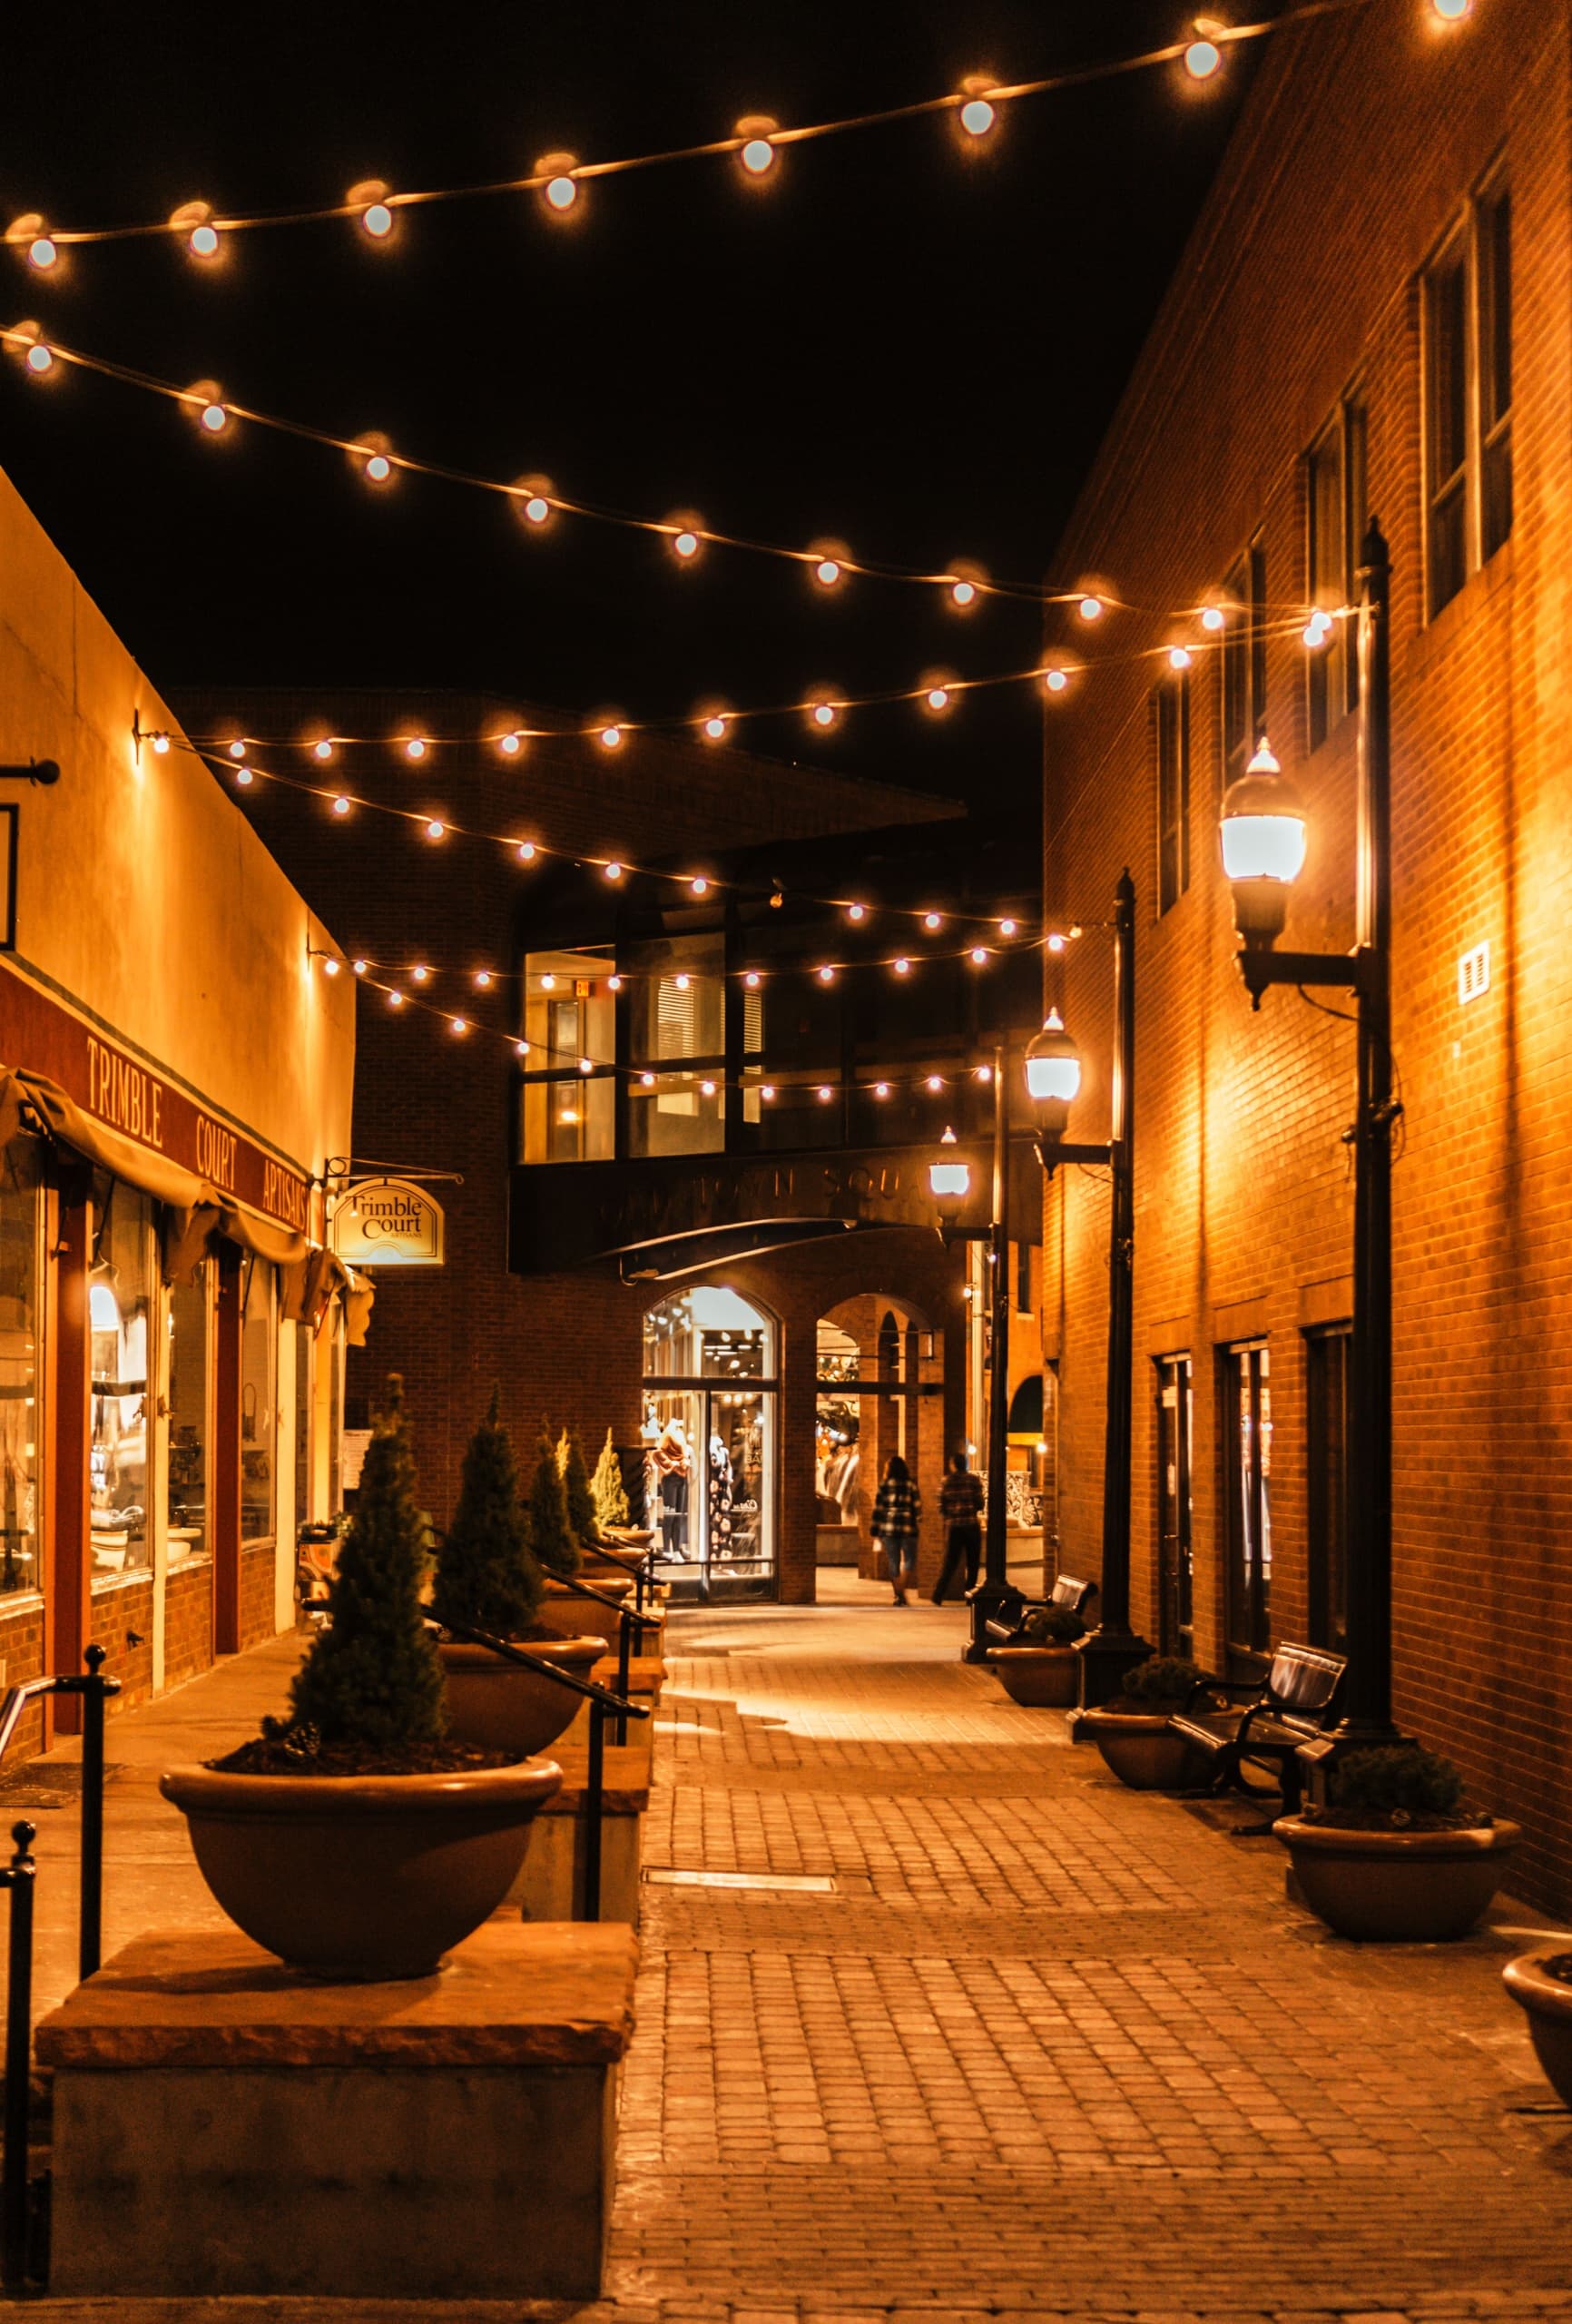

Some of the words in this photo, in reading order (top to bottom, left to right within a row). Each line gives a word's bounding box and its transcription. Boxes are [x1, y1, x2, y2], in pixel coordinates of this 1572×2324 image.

[87, 1035, 163, 1148] TRIMBLE
[196, 1114, 237, 1191] COURT
[262, 1157, 306, 1231] ARTISANS
[345, 1196, 422, 1216] Trimble
[362, 1217, 421, 1239] Court
